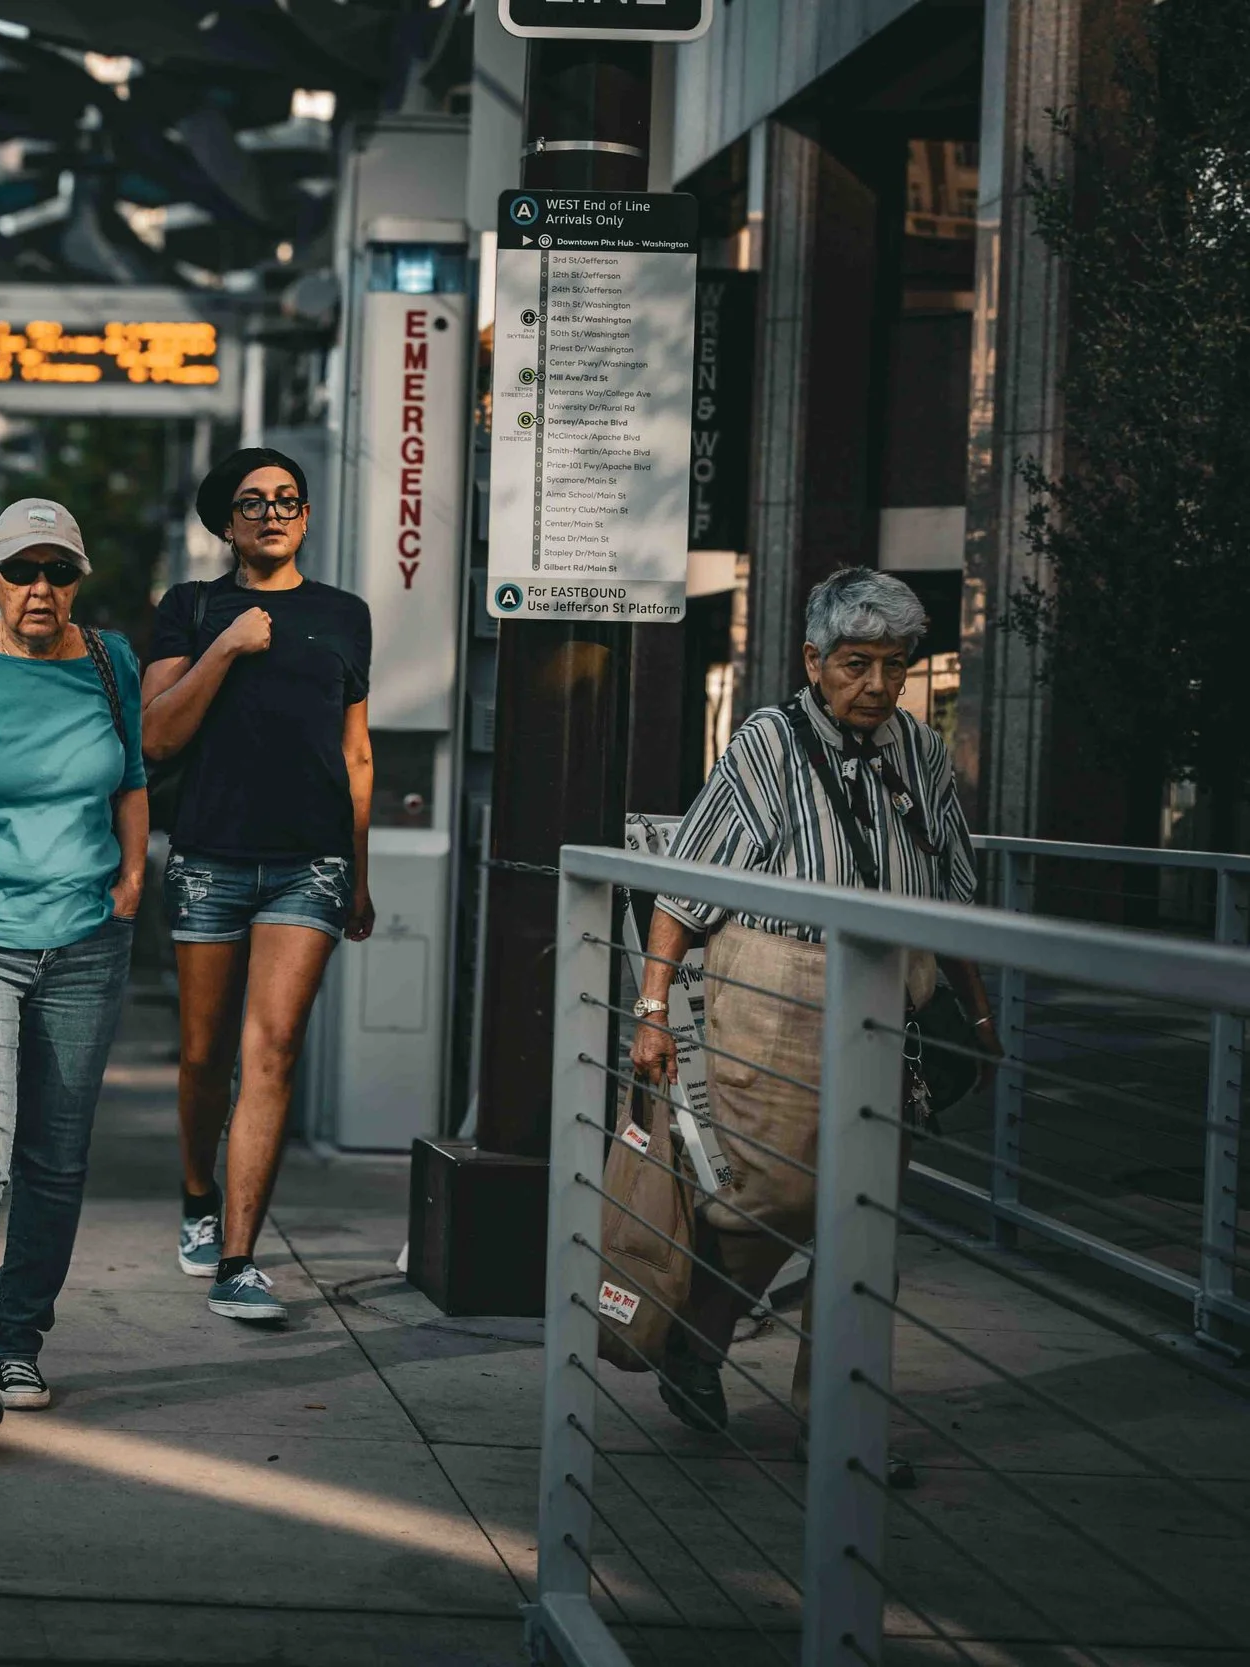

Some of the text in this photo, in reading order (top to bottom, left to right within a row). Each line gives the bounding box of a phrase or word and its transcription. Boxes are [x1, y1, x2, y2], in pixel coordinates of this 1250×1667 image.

[546, 199, 650, 212] WEST End of Line
[517, 203, 531, 218] A
[545, 214, 624, 228] Arrivals Only
[557, 238, 599, 246] Downtown
[601, 239, 615, 247] Phx
[641, 240, 689, 249] Washington
[569, 257, 618, 265] St/Jefferson
[552, 271, 621, 280] 12th St/Jefferson
[572, 286, 622, 294] St/Jefferson
[572, 301, 631, 310] St/Washington
[572, 316, 632, 325] St/Washington
[572, 331, 630, 340] St/Washington
[575, 345, 634, 354] Dr/Washington
[578, 360, 649, 370] Pkwy/Washington
[585, 389, 635, 399] Way/College
[548, 403, 586, 412] University
[589, 404, 622, 412] Dr/Rural
[548, 418, 608, 427] Dorsey/Apache
[548, 432, 621, 442] McClintock/Apache
[398, 310, 428, 590] EMERGENCY
[548, 447, 631, 457] Smith-Martin/Apache
[584, 463, 632, 472] Fwy/Apache
[546, 476, 607, 485] Sycamore/Main
[692, 430, 720, 539] WOLF
[568, 491, 616, 500] School/Main
[546, 506, 576, 515] Country
[545, 520, 593, 528] Center/Main
[568, 535, 599, 543] Dr/Main
[544, 549, 573, 558] Stapley
[575, 550, 607, 558] Dr/Main
[574, 564, 607, 572] Rd/Main
[528, 586, 626, 599] For EASTBOUND
[501, 590, 517, 605] A
[528, 601, 680, 615] Use Jefferson St Platform
